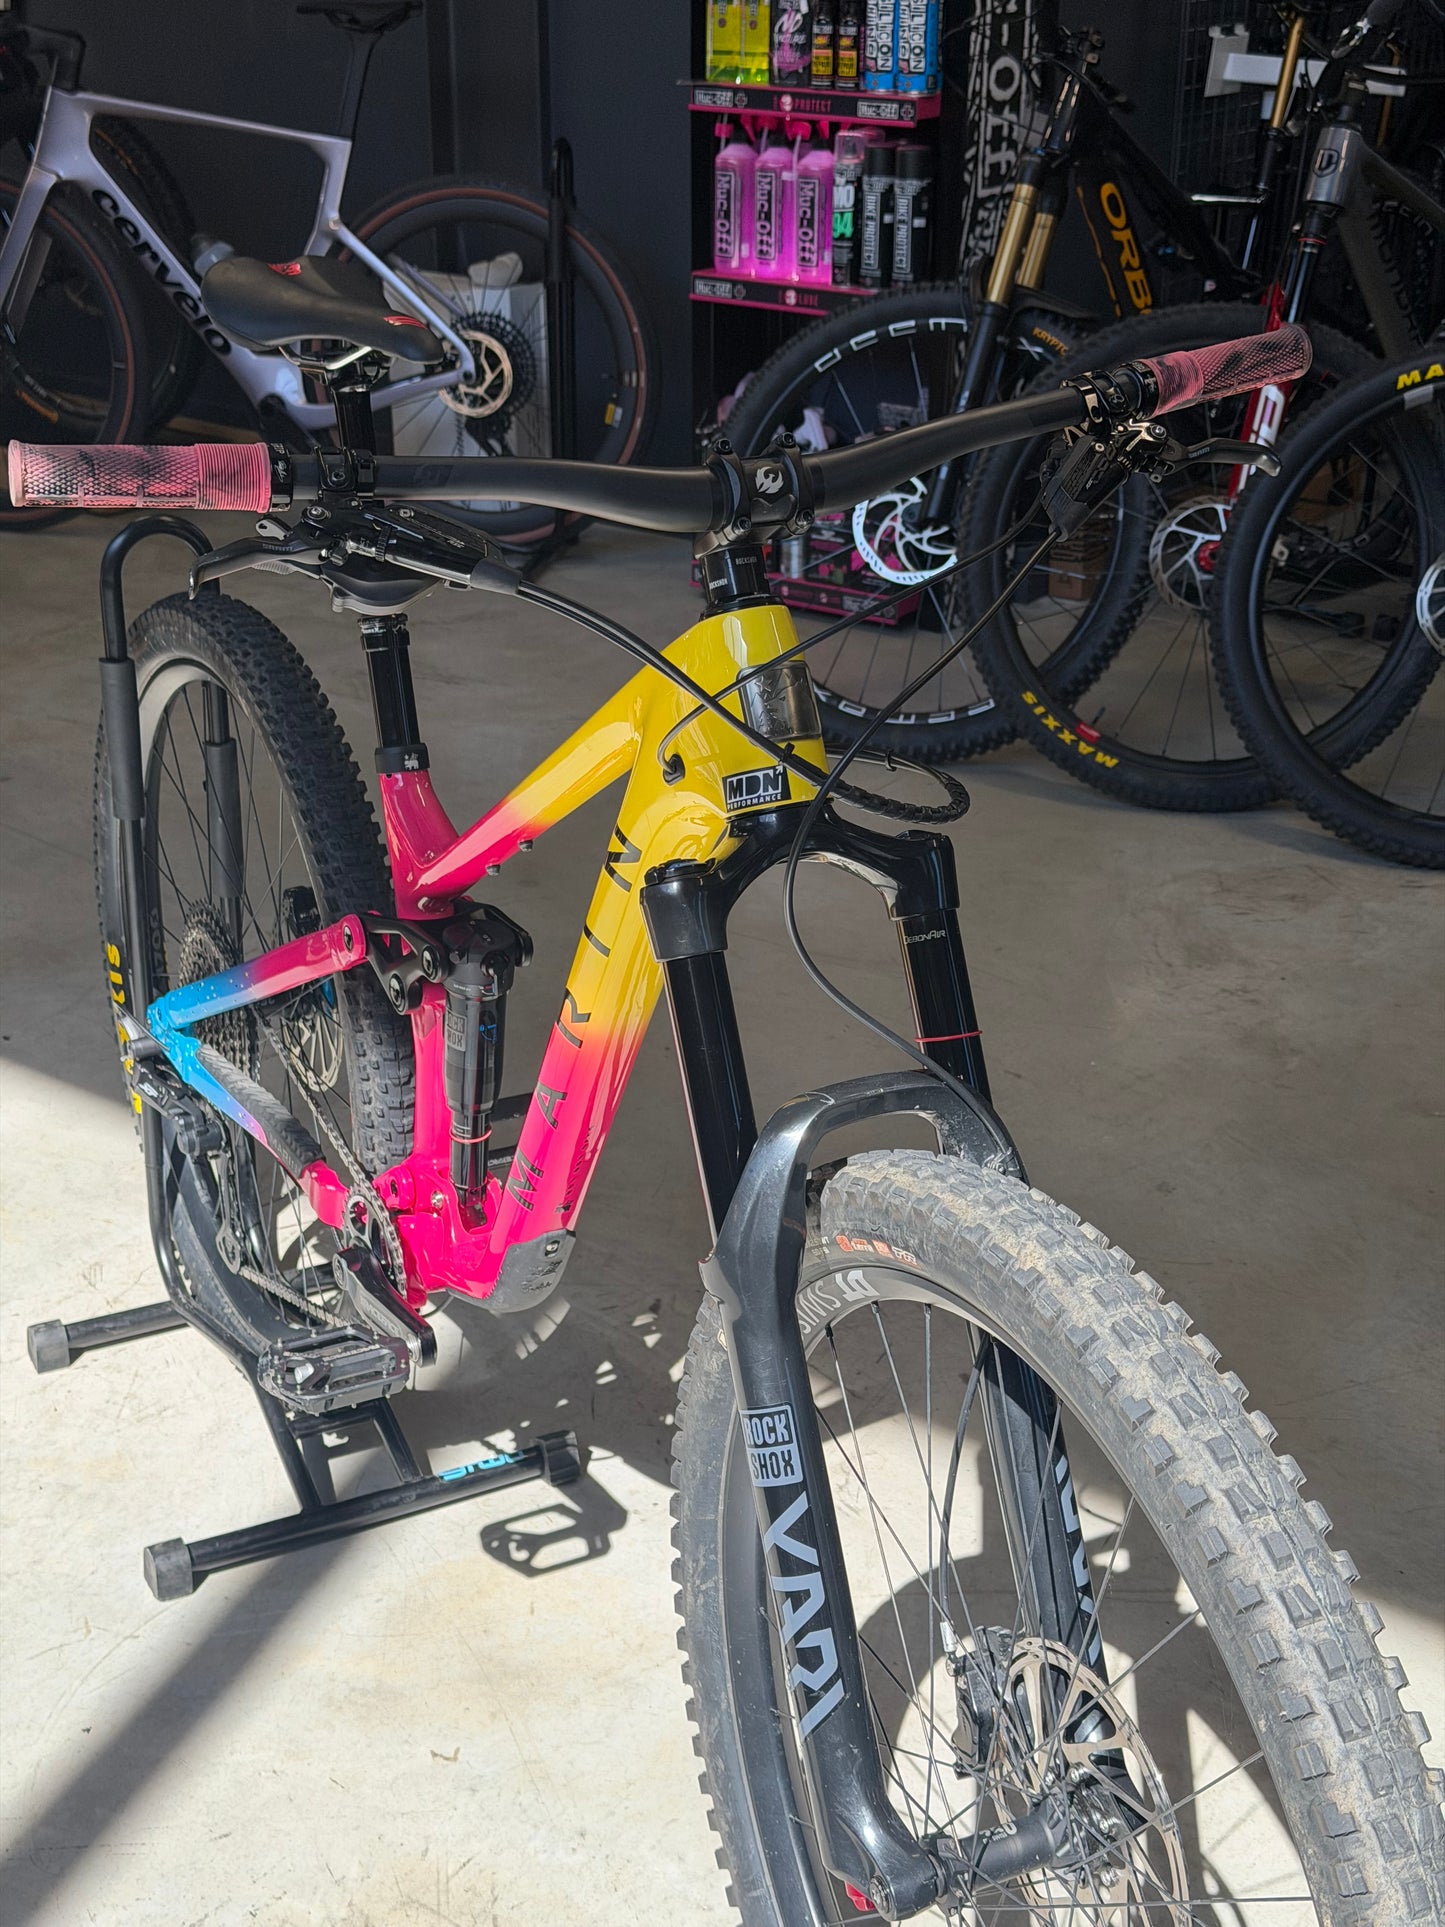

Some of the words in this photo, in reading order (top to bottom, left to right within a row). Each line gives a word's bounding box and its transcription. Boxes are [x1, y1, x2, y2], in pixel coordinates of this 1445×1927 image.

[717, 175, 732, 256] Muc-Off
[757, 176, 772, 257] Muc-Off
[799, 182, 814, 265] Muc-Off
[864, 221, 876, 268] PROTECT
[896, 224, 908, 271] PROTECT
[1021, 691, 1119, 768] MAXXIS
[726, 770, 782, 803] MDN
[727, 793, 782, 811] PERFORMANCE
[743, 1411, 790, 1447] ROCK
[751, 1449, 796, 1480] SHOX
